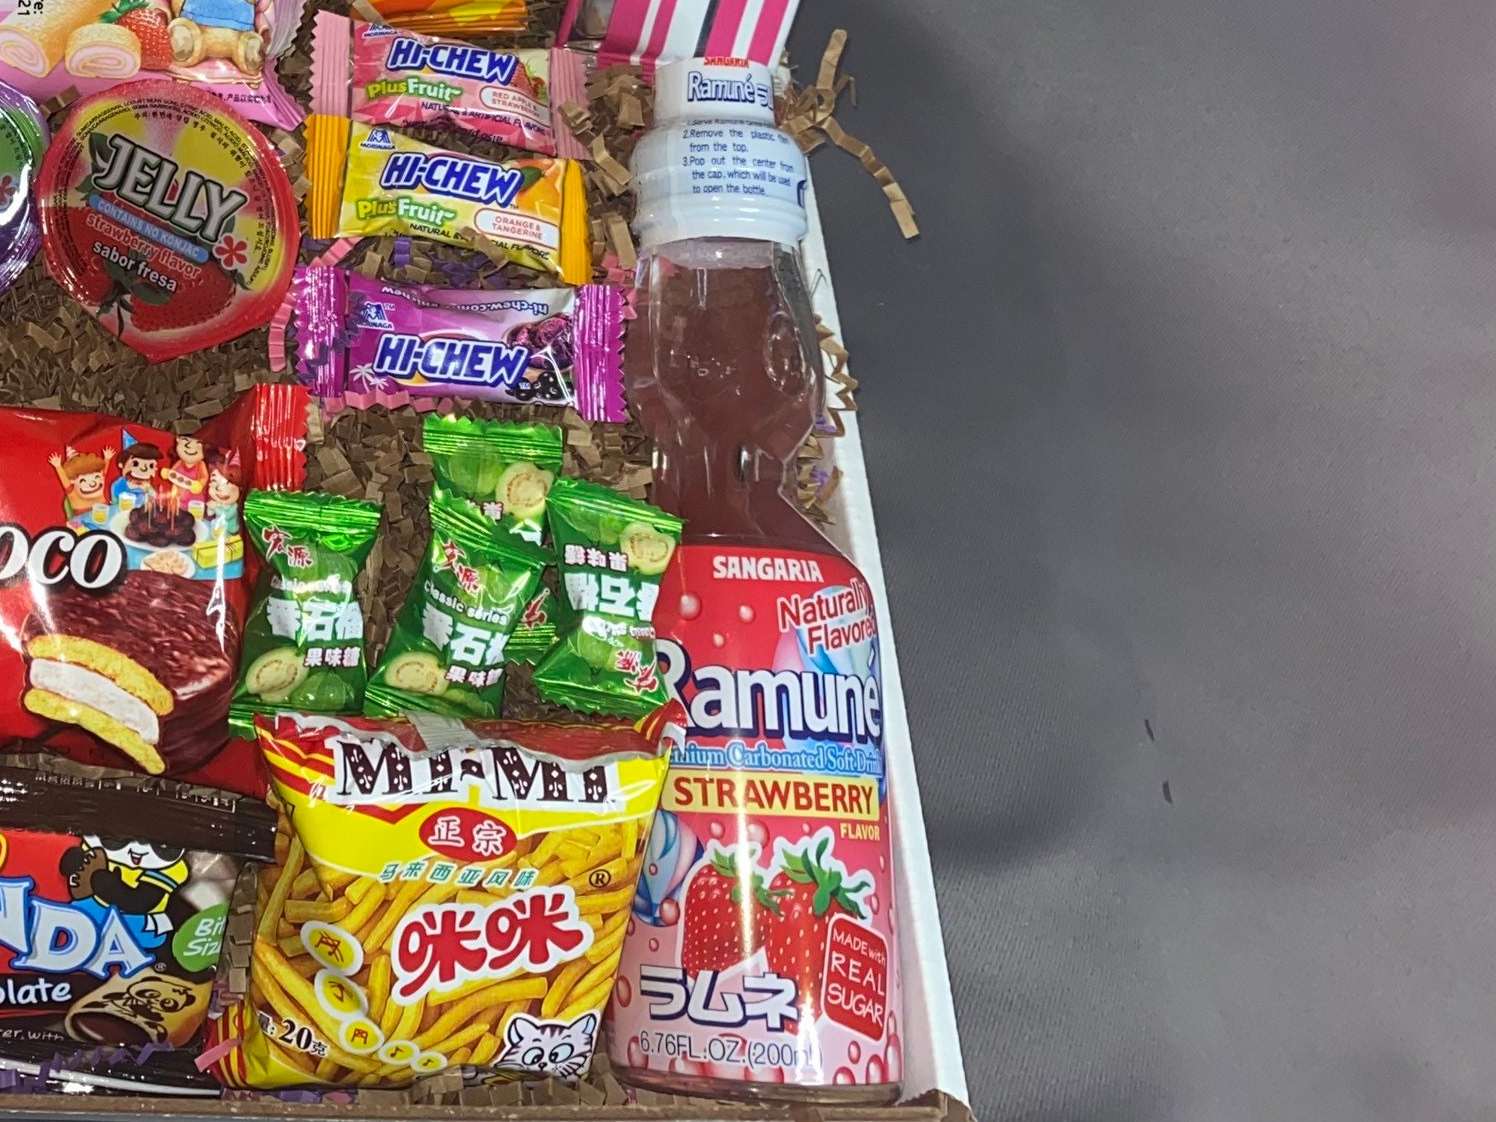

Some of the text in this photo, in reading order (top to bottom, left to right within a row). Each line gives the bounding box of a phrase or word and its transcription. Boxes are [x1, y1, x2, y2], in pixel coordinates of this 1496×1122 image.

[491, 91, 533, 108] RED APPLE
[687, 71, 756, 103] Ramuné
[491, 98, 540, 118] STRAWBERRY
[689, 141, 728, 153] from the
[729, 129, 776, 142] the plastic
[380, 153, 524, 208] HI-CHEW
[692, 169, 768, 182] the which will
[710, 156, 795, 173] out the center from
[92, 133, 248, 242] JELLY
[692, 183, 741, 195] to open the
[97, 201, 201, 258] CONTAINS NO KONJAC
[410, 223, 452, 239] NATURAL
[491, 223, 544, 241] TANGERINE
[494, 215, 534, 230] ORANGE
[86, 212, 202, 279] strawberry flavor
[93, 241, 179, 293] sabor fresa
[374, 334, 531, 386] HI-CHEW
[713, 555, 824, 583] SANGARIA
[267, 596, 364, 641] 番石榴
[424, 579, 464, 613] Classic
[466, 607, 509, 626] series
[778, 579, 873, 631] Naturally
[304, 647, 360, 667] 果味糖
[726, 740, 856, 773] Carbonated Soft
[674, 777, 874, 814] STRAWBERRY
[429, 816, 507, 854] 正宗
[840, 823, 881, 841] FLAVOR
[379, 859, 538, 887] 马来西亚风味
[398, 892, 584, 999] 咪咪
[833, 930, 887, 967] MADE with
[830, 951, 885, 997] REAL
[640, 964, 798, 1033] ラムネ
[827, 983, 884, 1028] SUGAR
